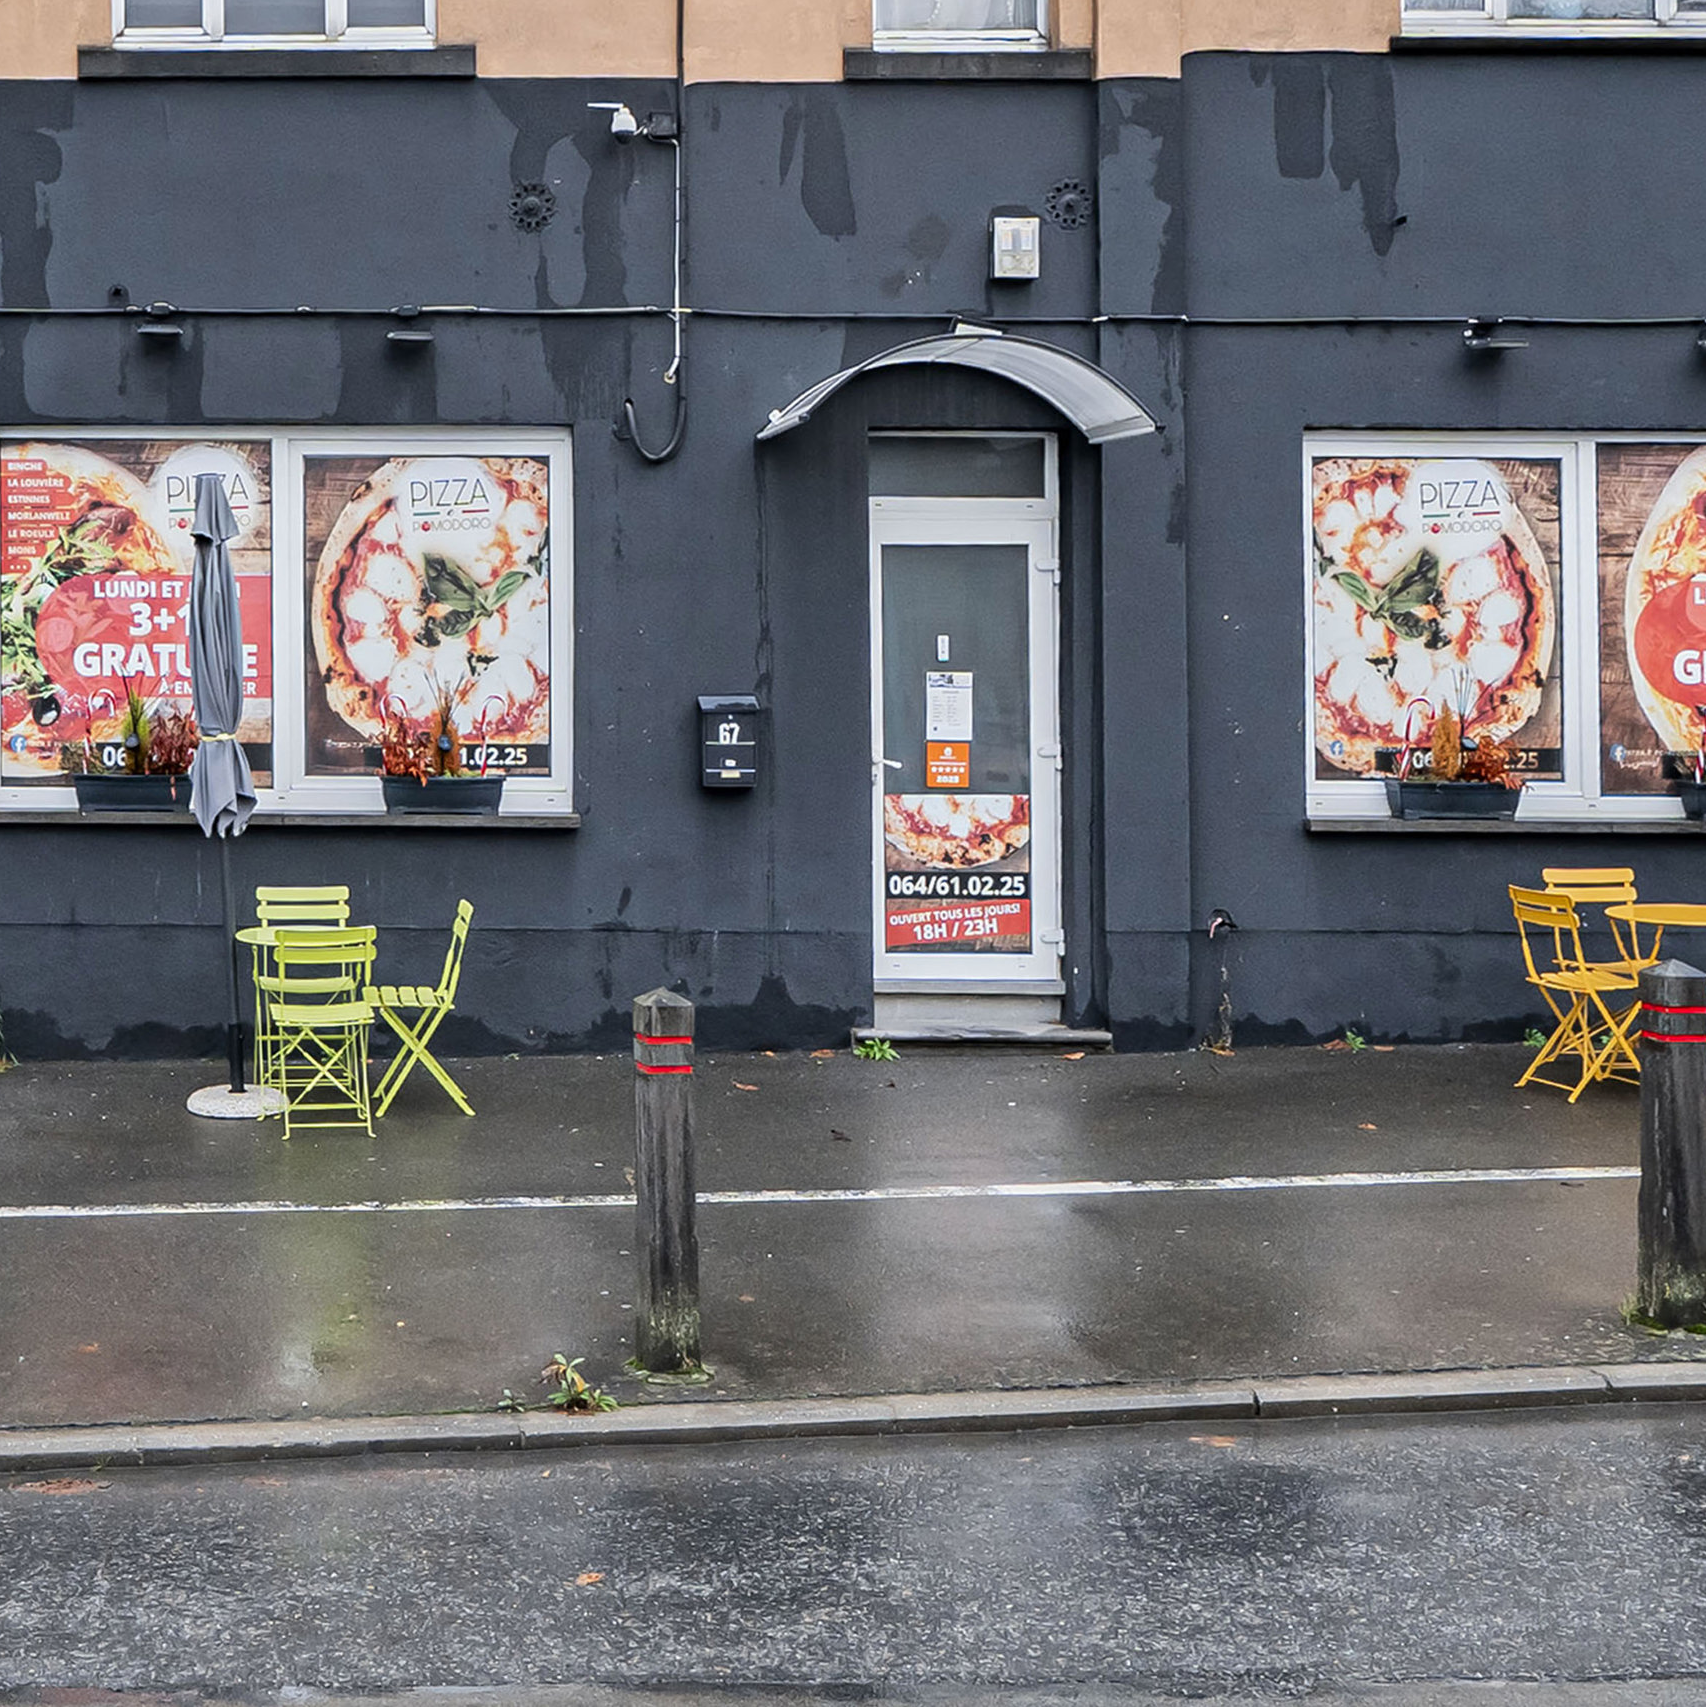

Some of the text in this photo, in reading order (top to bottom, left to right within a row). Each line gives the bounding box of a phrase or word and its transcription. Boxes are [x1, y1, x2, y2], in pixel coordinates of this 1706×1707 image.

[7, 476, 64, 487] LA LOUVIÈRE
[167, 473, 249, 504] PIA
[410, 478, 490, 508] PIZZA
[1420, 480, 1500, 510] PIZZA
[7, 529, 18, 538] LE
[412, 516, 491, 532] POMODORO
[1422, 519, 1503, 534] POMODORO
[7, 546, 36, 554] MONS
[93, 581, 156, 598] LUNDI
[161, 581, 183, 598] ET
[719, 722, 740, 744] 67
[889, 875, 1025, 896] 064/61.02.25
[889, 903, 1021, 926] OUVERT TOUS LES JOURS!
[913, 922, 948, 940] 18H
[963, 918, 998, 936] 23H
